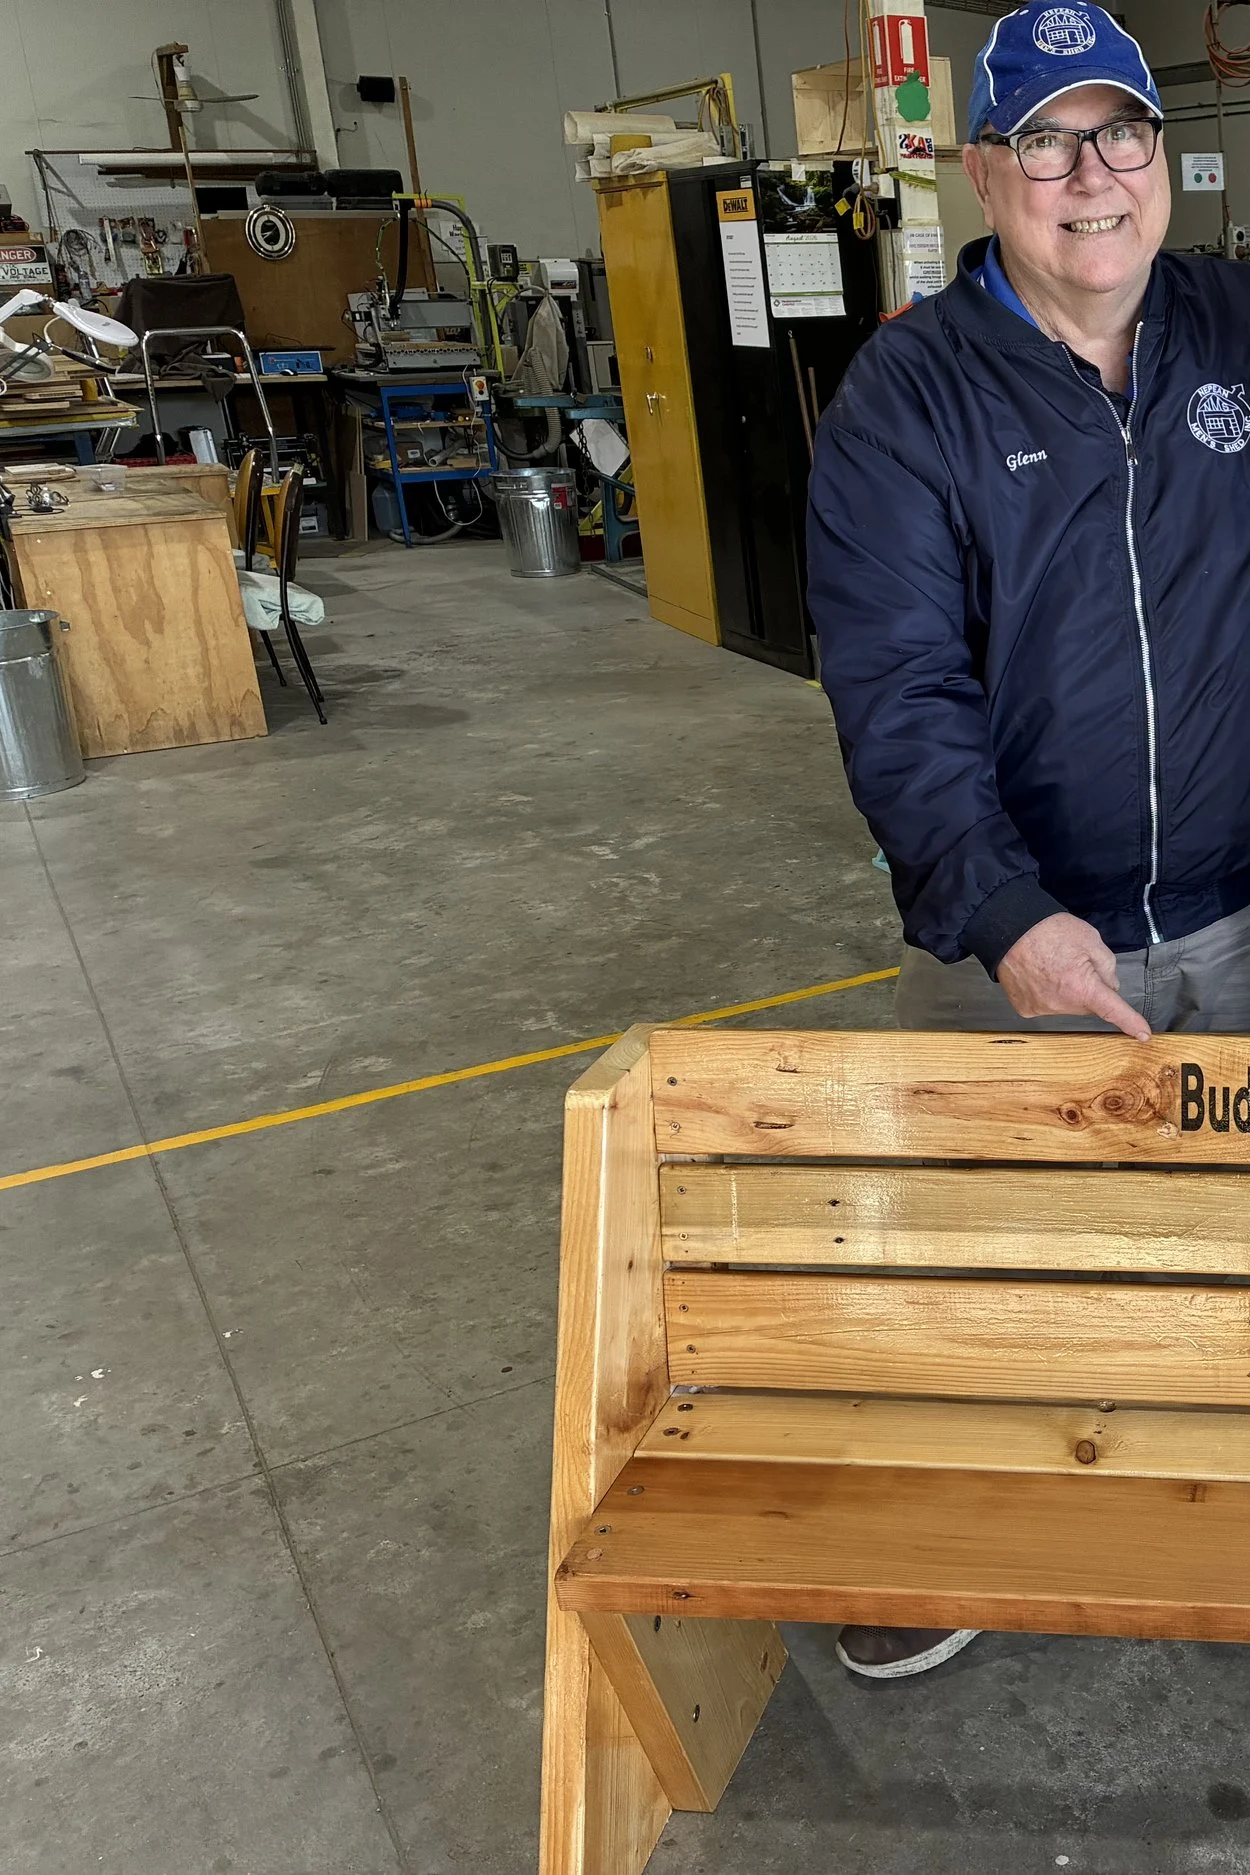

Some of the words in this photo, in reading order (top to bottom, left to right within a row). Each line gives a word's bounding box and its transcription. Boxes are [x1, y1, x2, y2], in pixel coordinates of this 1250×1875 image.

[0, 250, 31, 260] NGER
[3, 267, 49, 276] VOLTAGE
[1197, 384, 1230, 398] NEPEAN
[1203, 396, 1230, 412] NMS
[1190, 422, 1217, 448] MEN'S
[1223, 438, 1245, 452] SHED
[1006, 449, 1048, 471] Glenn
